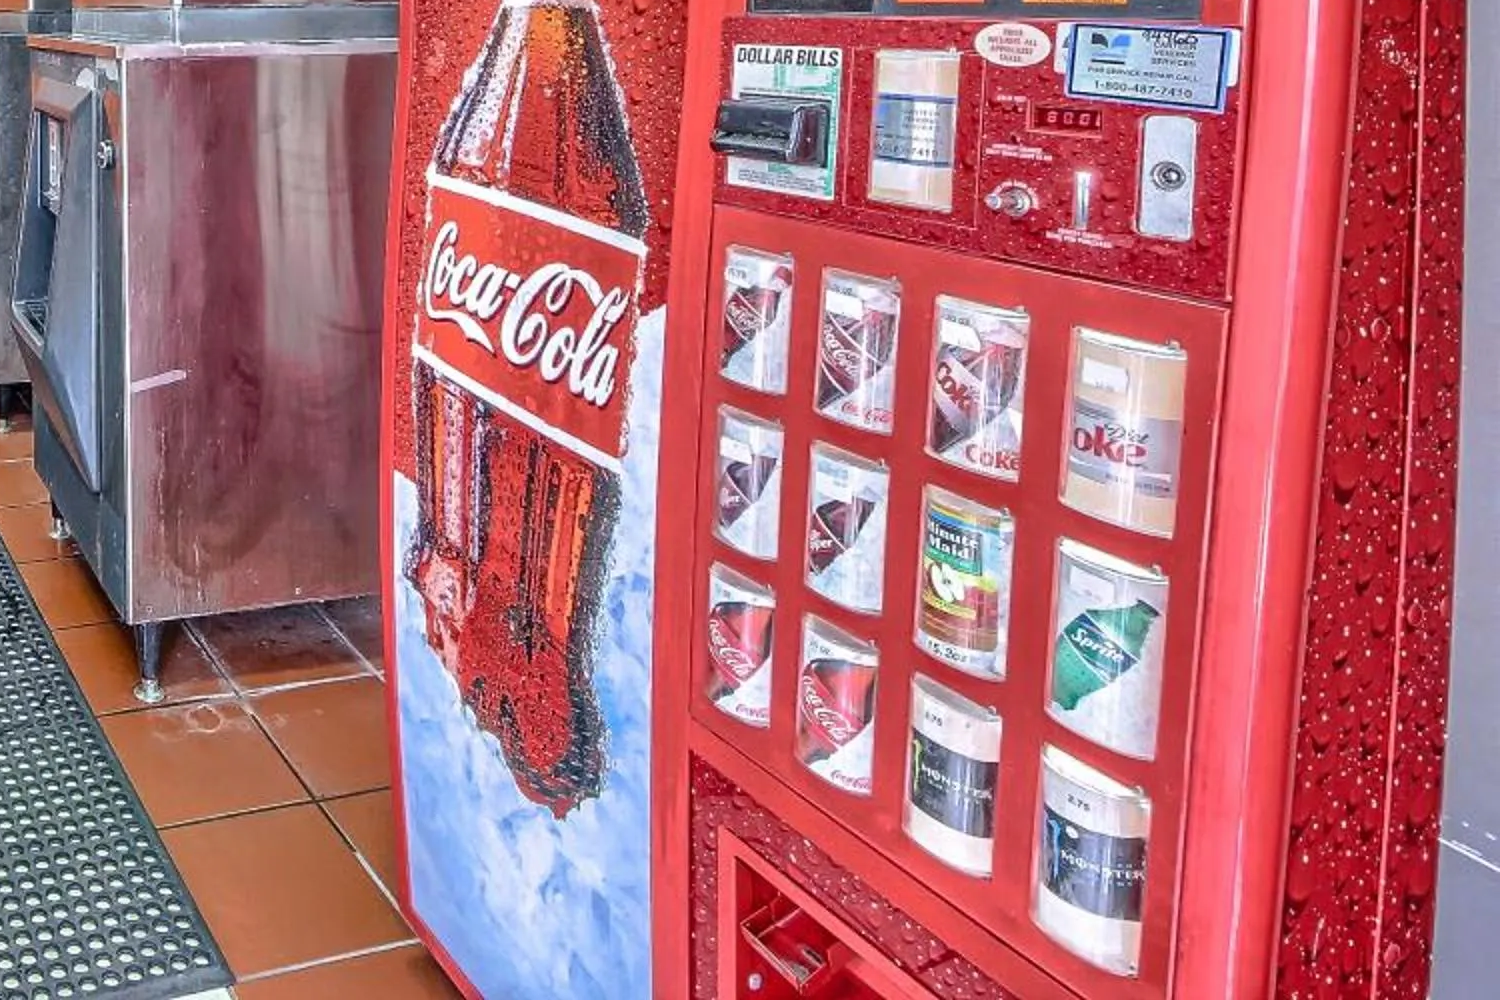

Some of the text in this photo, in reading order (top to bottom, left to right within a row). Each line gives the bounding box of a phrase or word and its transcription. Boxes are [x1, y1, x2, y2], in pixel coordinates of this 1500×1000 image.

[737, 47, 839, 67] DOLLAR BILLS
[1106, 67, 1140, 76] SERVICE
[425, 221, 631, 406] Coca-Cola
[965, 444, 1021, 471] Coke
[1071, 627, 1125, 663] Sprite
[921, 763, 993, 801] MONSTER
[1067, 793, 1090, 811] 2.75
[1061, 849, 1146, 882] MONSTER
